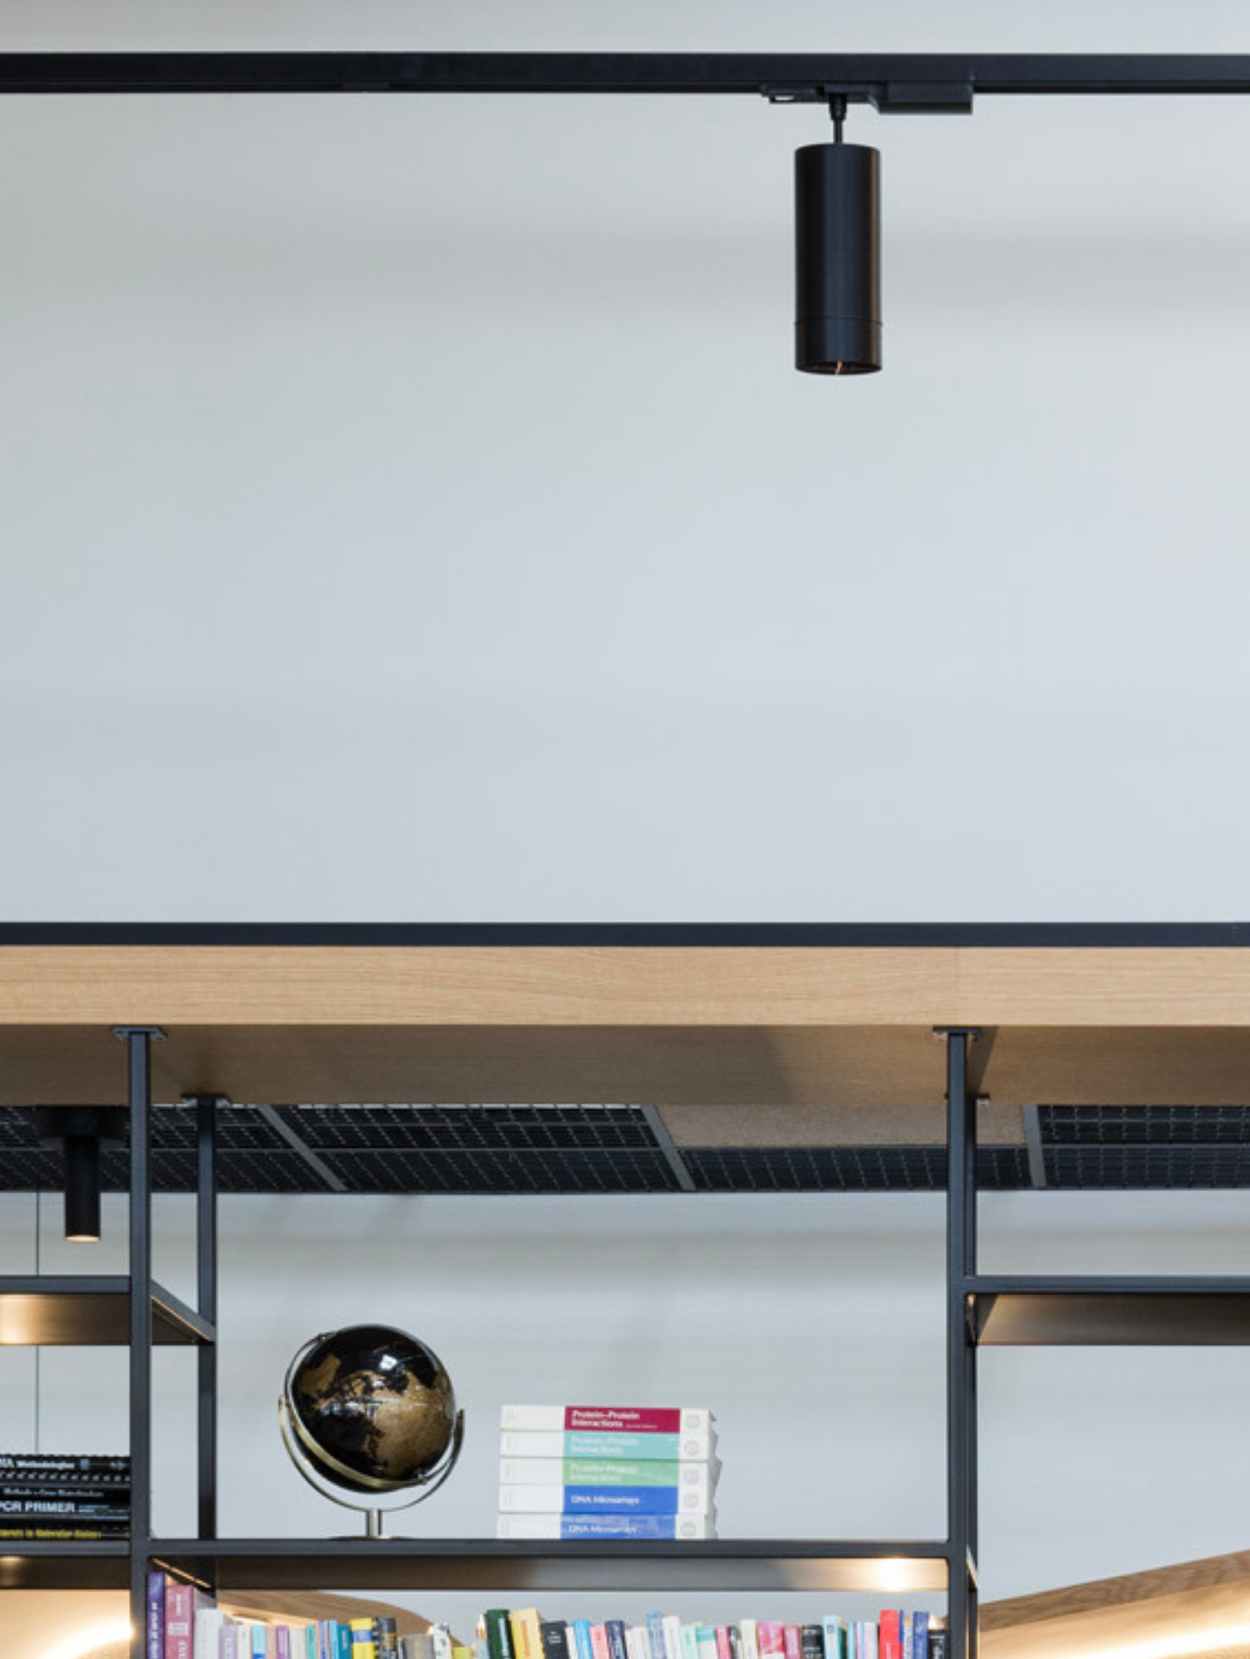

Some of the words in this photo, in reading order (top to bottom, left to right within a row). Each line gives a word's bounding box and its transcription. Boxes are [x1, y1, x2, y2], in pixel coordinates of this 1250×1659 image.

[572, 1419, 622, 1428] Interactions
[571, 1446, 622, 1454] Interactions
[571, 1496, 591, 1504] DNA
[593, 1496, 639, 1505] Microarrays
[25, 1501, 75, 1512] PRIMER
[568, 1525, 589, 1533] DNA
[590, 1526, 636, 1535] Microarrays
